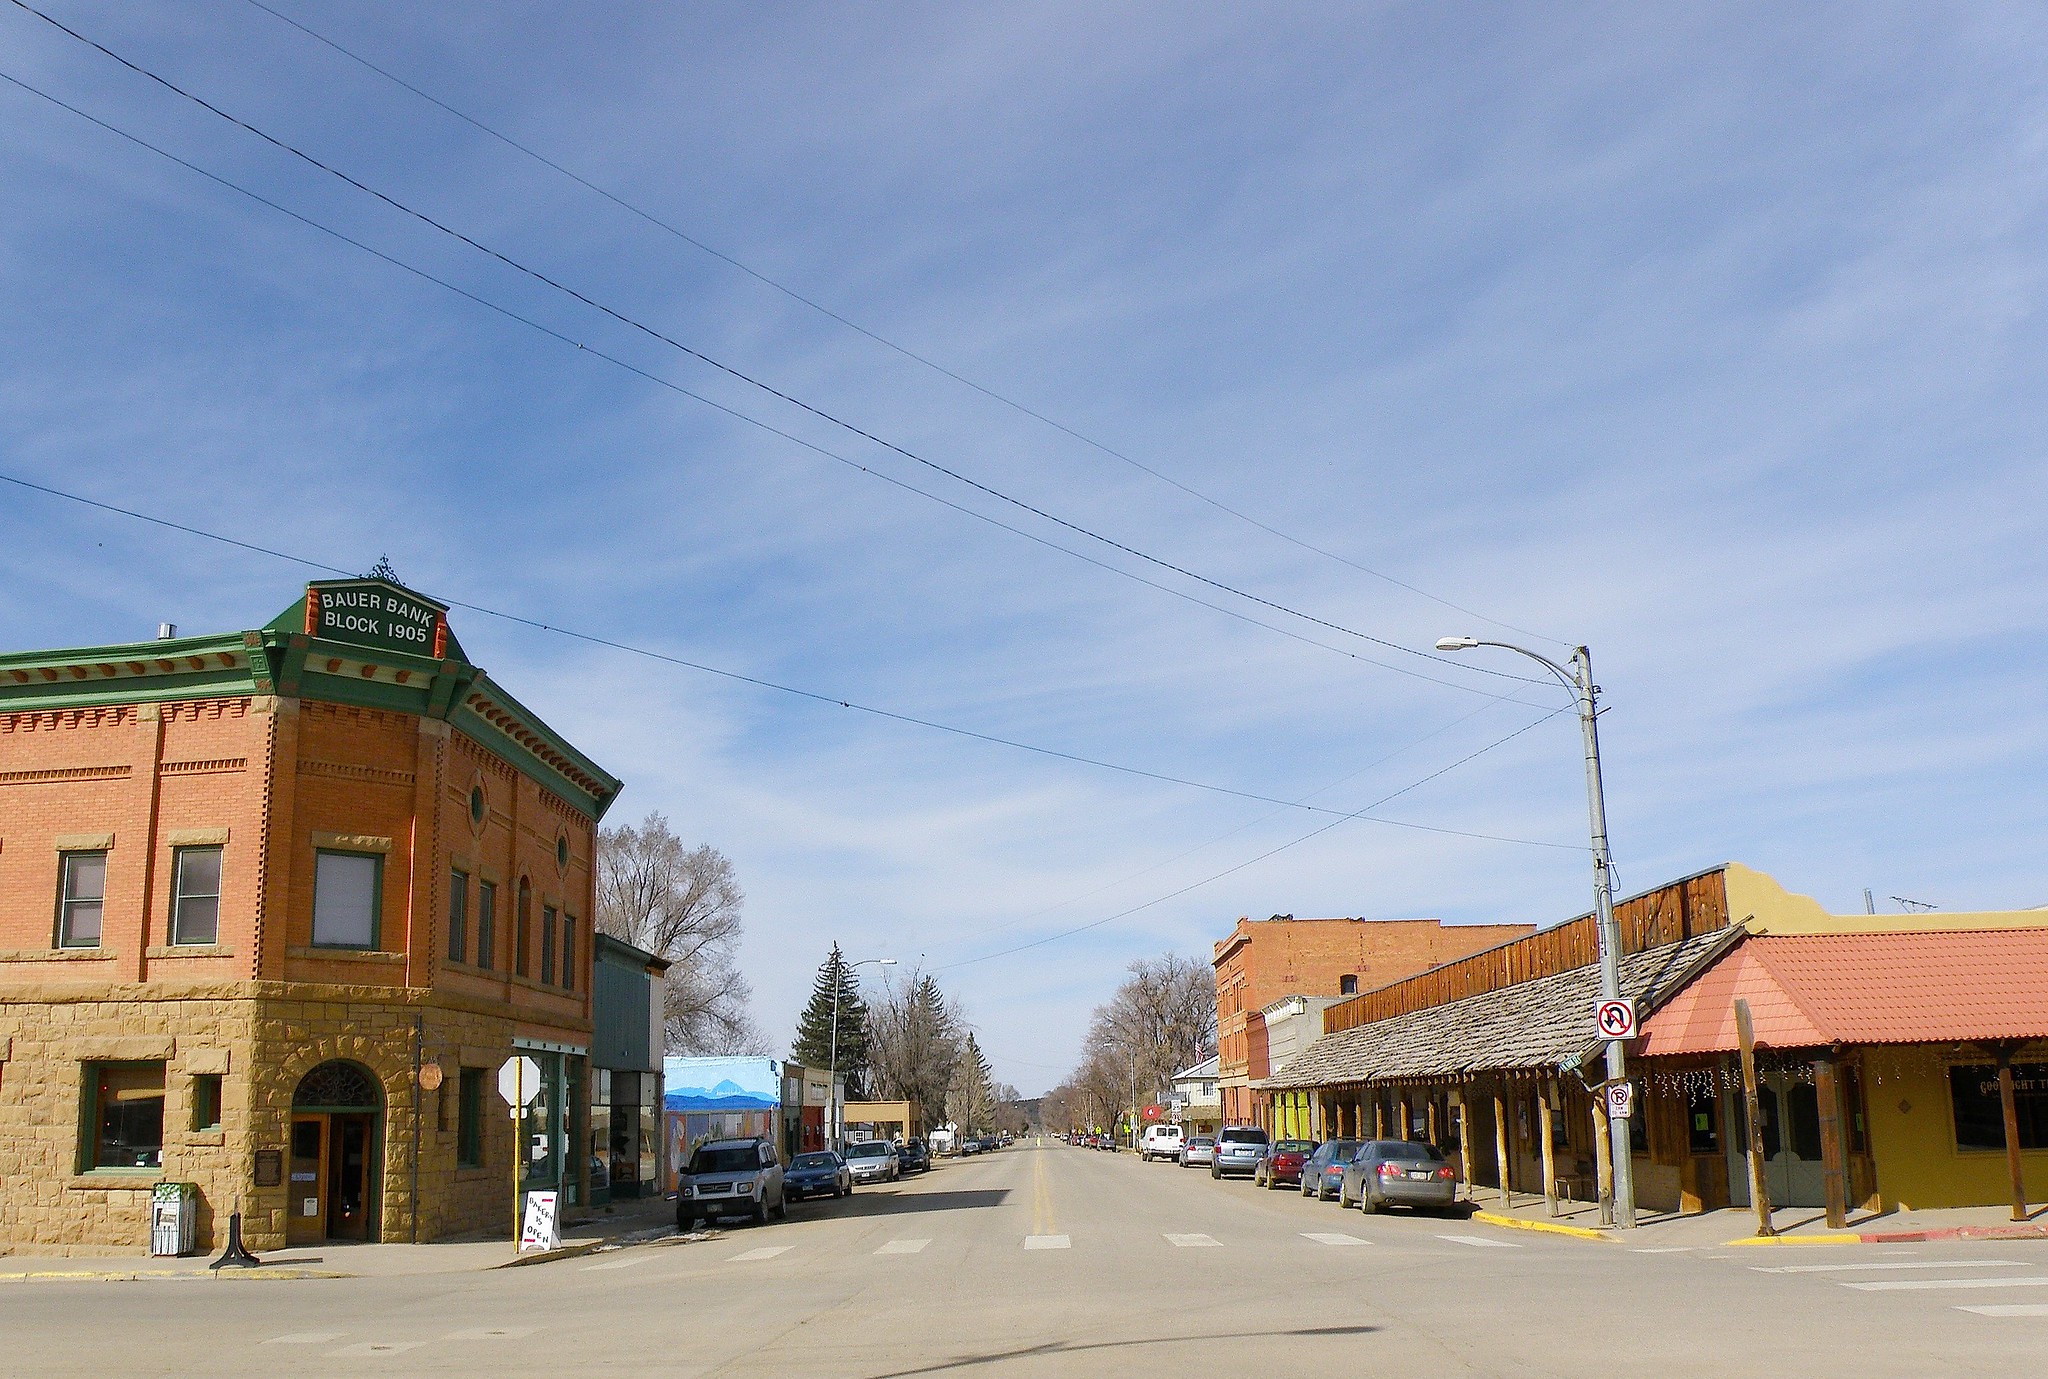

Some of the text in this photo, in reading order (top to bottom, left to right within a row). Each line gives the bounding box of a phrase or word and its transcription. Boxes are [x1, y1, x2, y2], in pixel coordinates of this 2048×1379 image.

[322, 592, 434, 628] BAUER BANK
[325, 611, 427, 642] BLOCK 1905
[529, 1197, 553, 1222] BAKERY
[536, 1216, 542, 1225] IS
[527, 1225, 549, 1243] OPEN
